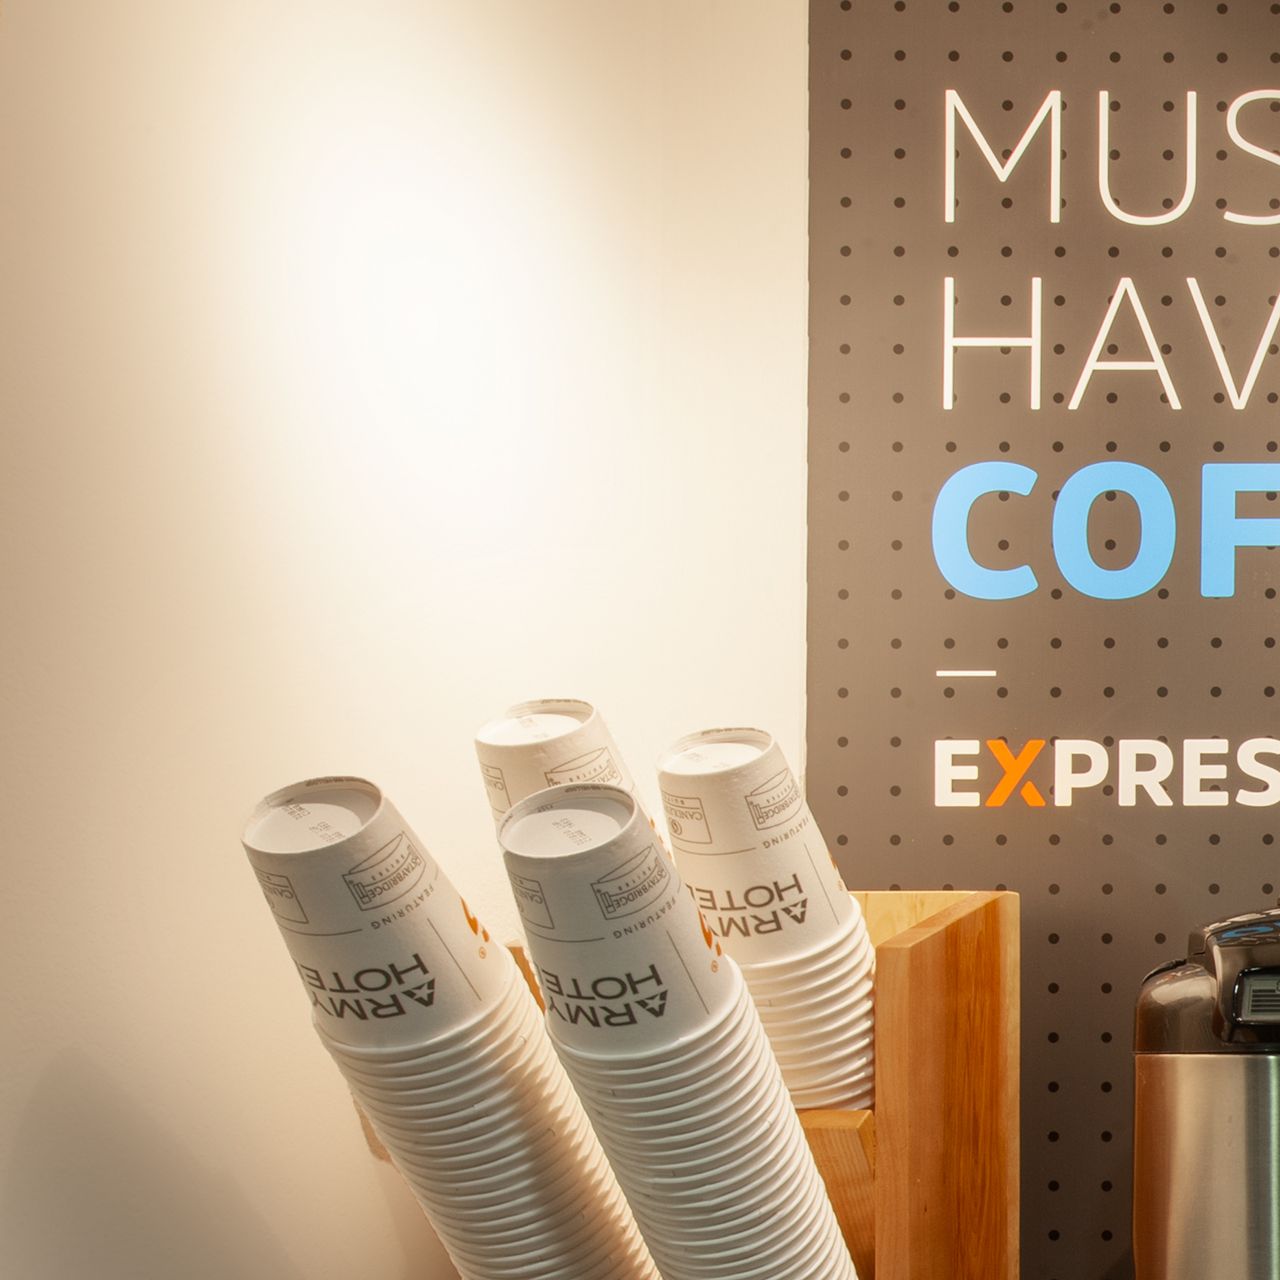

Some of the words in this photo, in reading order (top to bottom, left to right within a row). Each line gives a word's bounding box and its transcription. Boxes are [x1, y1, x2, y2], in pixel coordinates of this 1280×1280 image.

[367, 857, 421, 898] STAYBRIDGE
[614, 867, 665, 910] STAYBRIDGE
[371, 884, 435, 931] FEATURING
[612, 896, 677, 940] FEATURING
[312, 977, 436, 1021] ARMY
[549, 989, 668, 1028] ARMY
